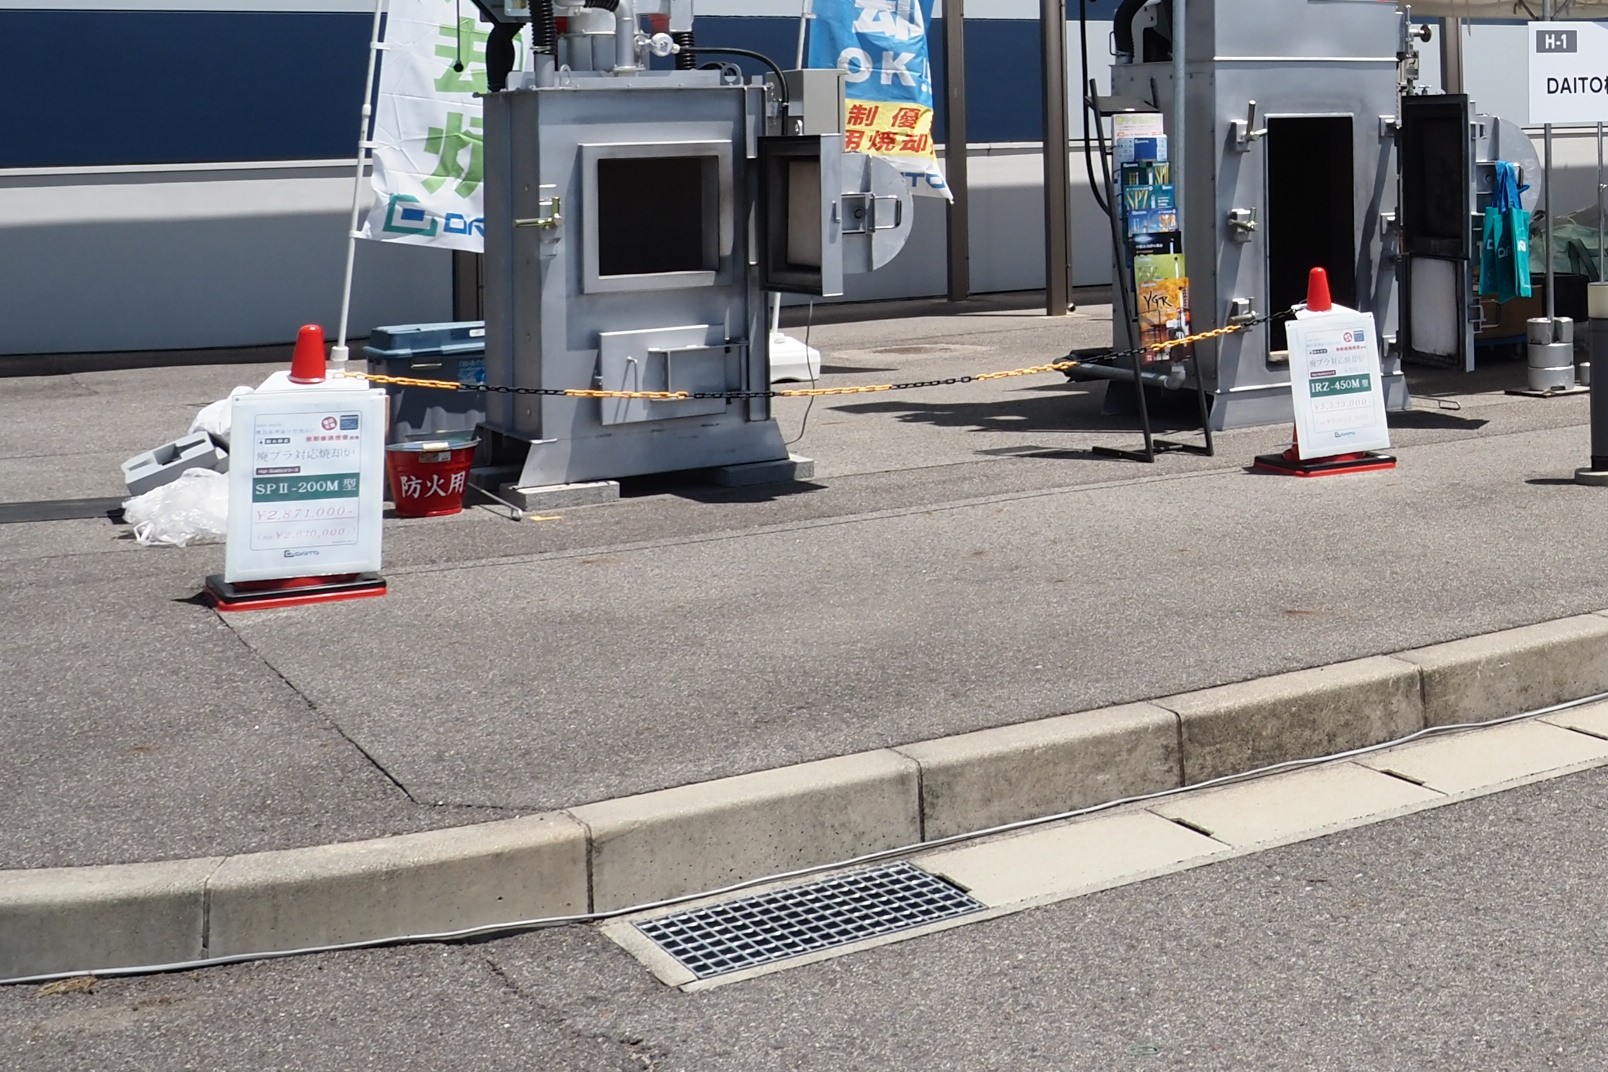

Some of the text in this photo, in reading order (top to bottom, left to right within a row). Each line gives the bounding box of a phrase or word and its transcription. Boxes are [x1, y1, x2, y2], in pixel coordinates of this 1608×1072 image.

[1545, 33, 1567, 49] H-1
[401, 471, 466, 499] 防火用
